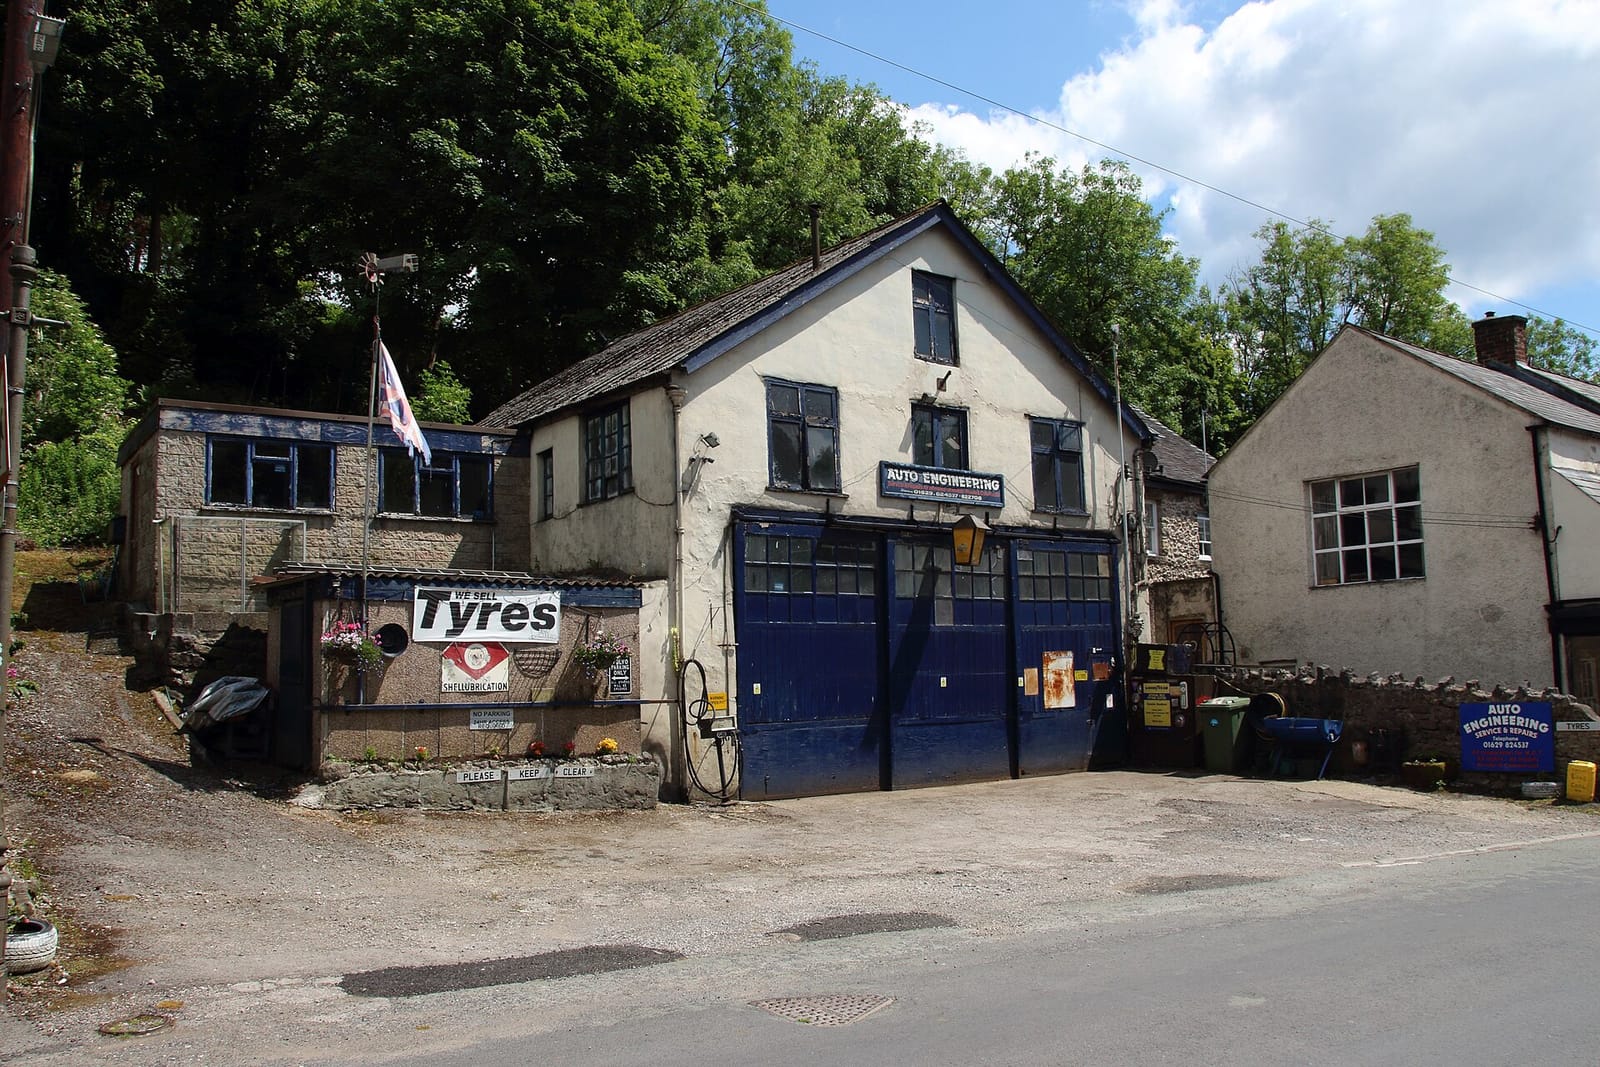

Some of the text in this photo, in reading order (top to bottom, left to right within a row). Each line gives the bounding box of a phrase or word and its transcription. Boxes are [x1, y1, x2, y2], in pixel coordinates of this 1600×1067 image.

[887, 468, 918, 482] AUTO
[923, 472, 1000, 491] ENGINEERING
[455, 591, 498, 601] WE SELL
[417, 589, 558, 638] Tyres
[443, 682, 508, 692] SHELLUBRICATION
[1488, 704, 1521, 715] AUTO
[1463, 715, 1549, 734] ENGINEERING
[1566, 722, 1590, 730] TYRES
[1475, 727, 1501, 739] SERVICE
[1509, 727, 1537, 739] REPAIRS
[463, 771, 495, 781] PLEASE
[519, 769, 540, 778] KEEP
[563, 767, 587, 776] CLEAR
